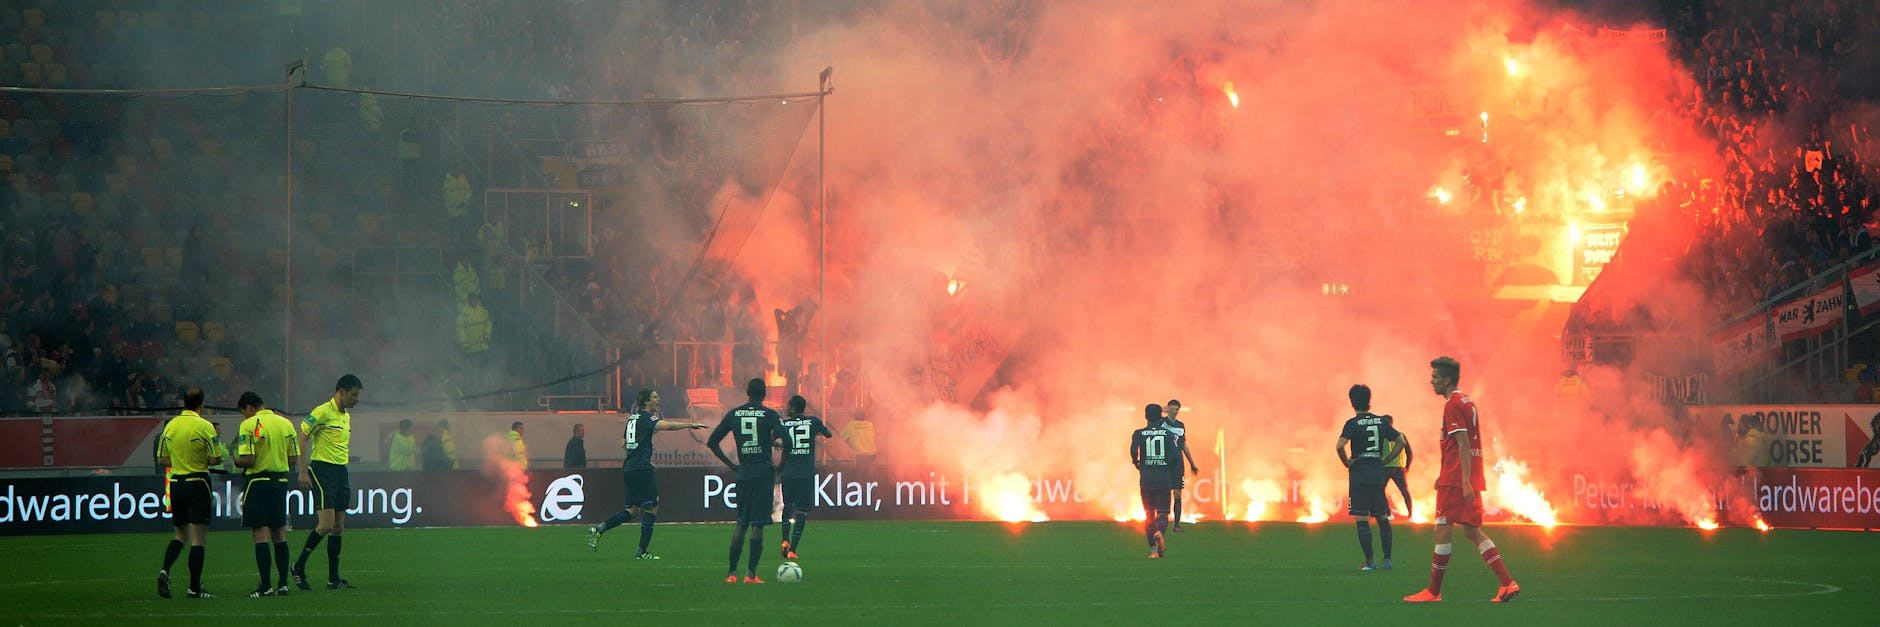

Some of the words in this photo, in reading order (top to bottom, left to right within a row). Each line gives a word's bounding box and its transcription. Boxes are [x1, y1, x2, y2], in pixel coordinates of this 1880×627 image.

[741, 417, 758, 447] 9
[788, 425, 810, 448] 12
[1366, 425, 1379, 451] 3
[1145, 435, 1165, 459] 10
[1769, 439, 1823, 463] ORSE
[814, 472, 882, 511] Klar,
[896, 472, 950, 506] mit
